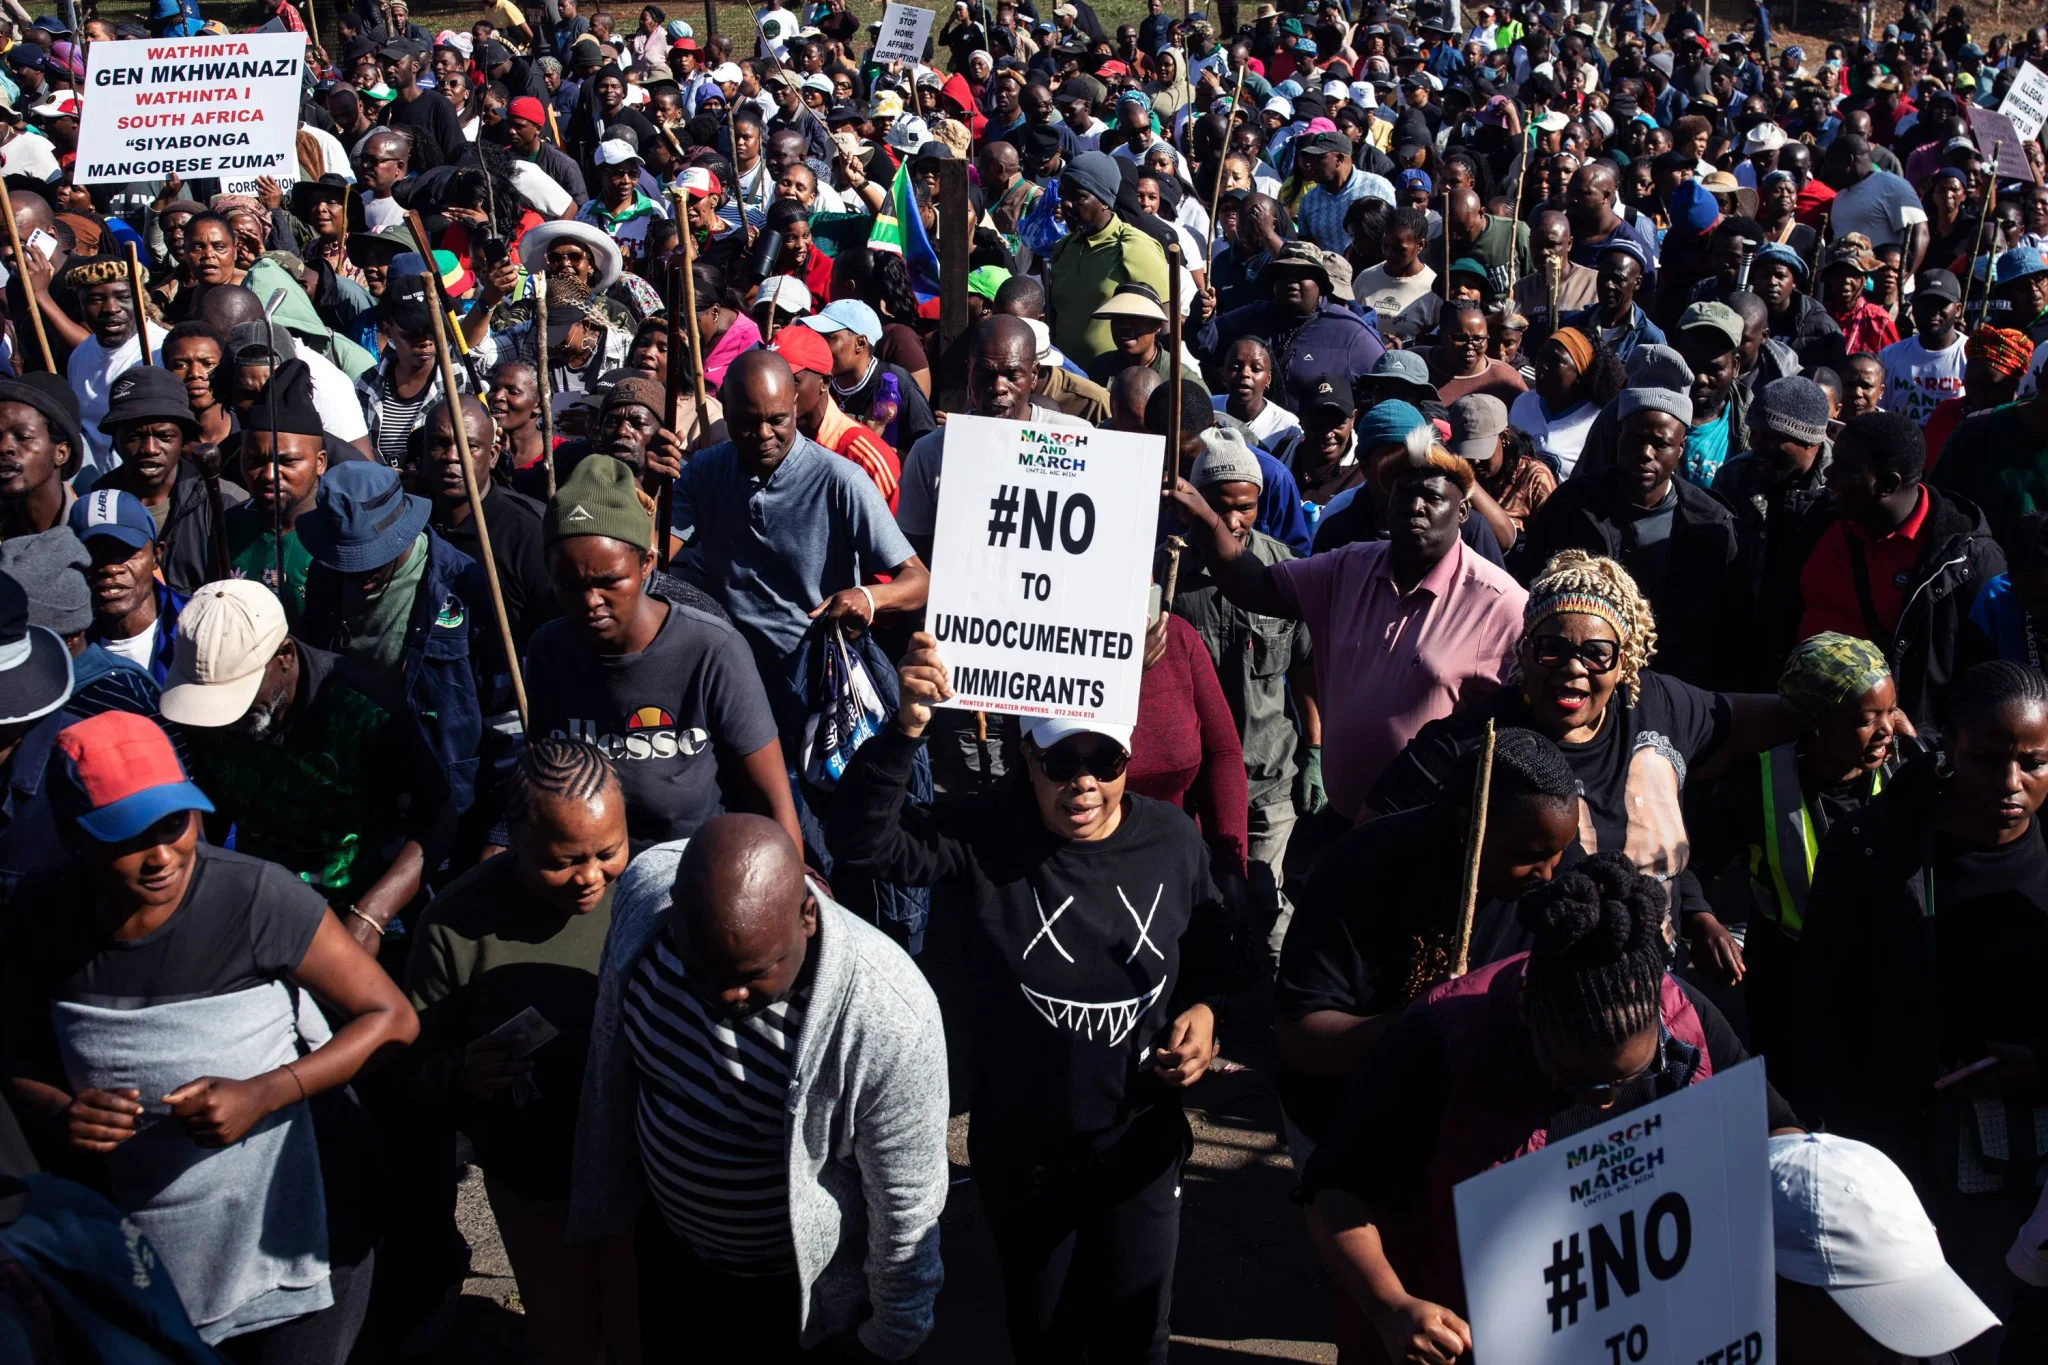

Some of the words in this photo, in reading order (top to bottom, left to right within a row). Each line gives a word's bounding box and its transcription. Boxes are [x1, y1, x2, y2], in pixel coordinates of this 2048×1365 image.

[899, 17, 917, 27] STOP
[894, 29, 915, 39] HOME
[147, 43, 249, 60] WATHINTA
[887, 40, 915, 51] AFFAIRS
[95, 67, 143, 86] GEN
[151, 59, 297, 83] MKHWANAZI
[136, 87, 238, 106] WATHINTA
[244, 87, 251, 99] I
[2020, 82, 2044, 105] ILLEGAL
[2006, 92, 2044, 124] IMMIGRATION
[117, 113, 185, 129] SOUTH
[191, 109, 264, 125] AFRICA
[2023, 123, 2033, 136] US
[88, 157, 212, 177] MANGOBESE
[1021, 429, 1088, 447] MARCH
[1040, 445, 1067, 456] AND
[1018, 453, 1086, 472] MARCH
[1026, 467, 1047, 475] UNTIL
[988, 484, 1096, 555] #NO
[1021, 571, 1051, 602] TO
[934, 613, 1134, 660] UNDOCUMENTED
[953, 666, 1105, 708] IMMIGRANTS
[959, 699, 984, 707] PRINTED
[995, 703, 1019, 711] MASTER
[1020, 705, 1049, 714] PRINTERS
[1566, 1113, 1661, 1170] MARCH
[1597, 1146, 1636, 1172] AND
[1570, 1147, 1664, 1203] MARCH
[1543, 1191, 1692, 1334] #NO
[1605, 1323, 1649, 1365] TO
